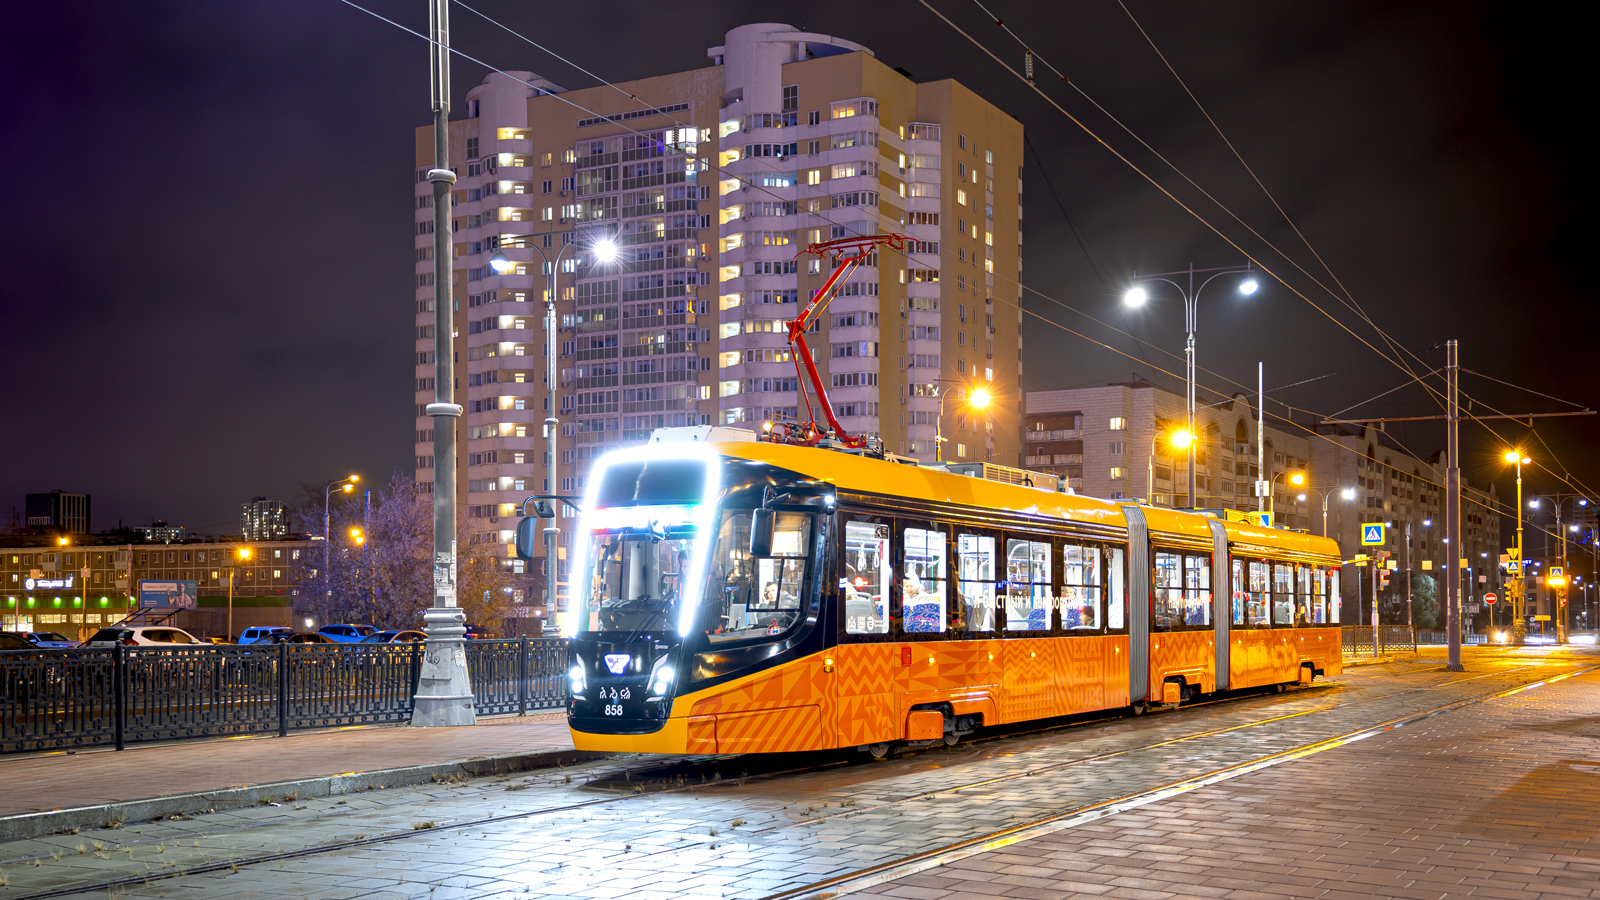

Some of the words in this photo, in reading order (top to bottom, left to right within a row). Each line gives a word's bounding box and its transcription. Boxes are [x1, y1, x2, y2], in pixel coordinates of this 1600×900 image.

[982, 590, 1023, 614] бстрый
[1073, 637, 1103, 659] EKAT
[1073, 660, 1104, 684] ERIN
[1073, 684, 1104, 710] BURG
[605, 704, 623, 716] 858
